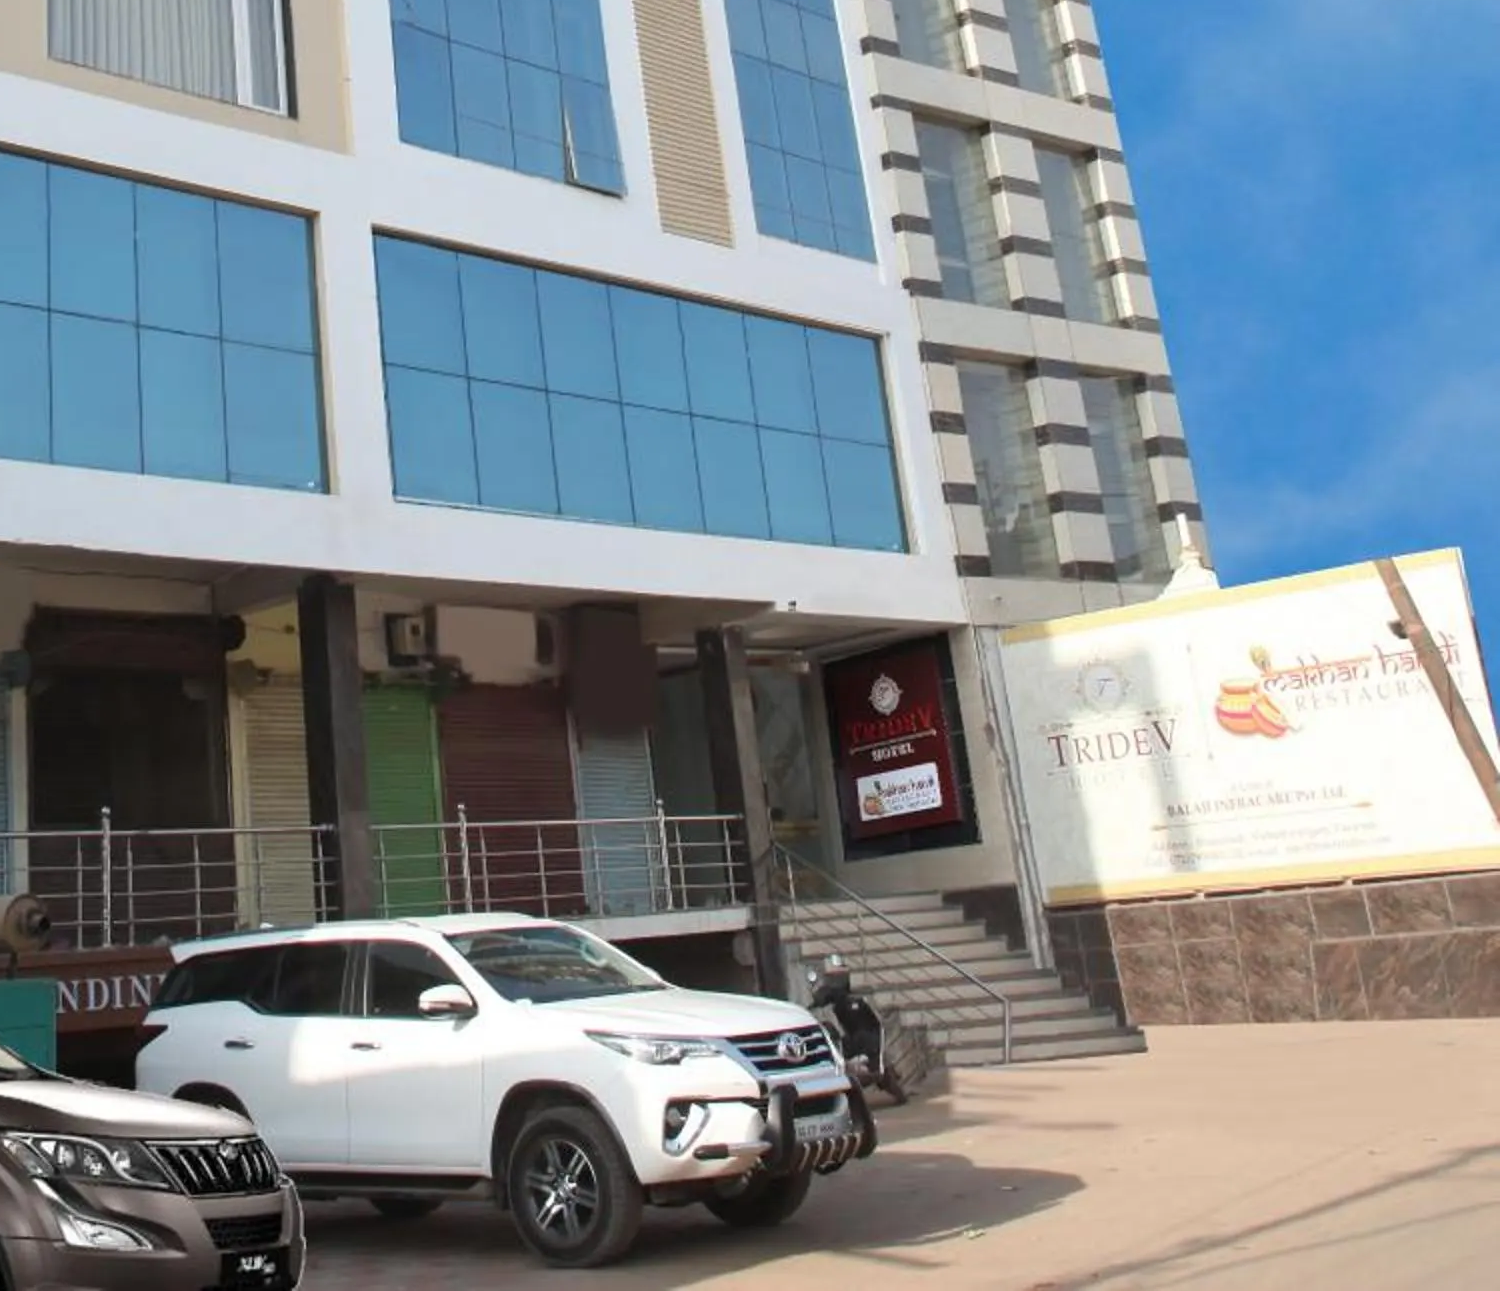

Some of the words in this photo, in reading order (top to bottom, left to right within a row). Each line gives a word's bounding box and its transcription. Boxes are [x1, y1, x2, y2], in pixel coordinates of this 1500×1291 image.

[1373, 630, 1461, 675] hadi
[871, 742, 915, 762] HOTEL
[1047, 718, 1177, 768] TRIDEV
